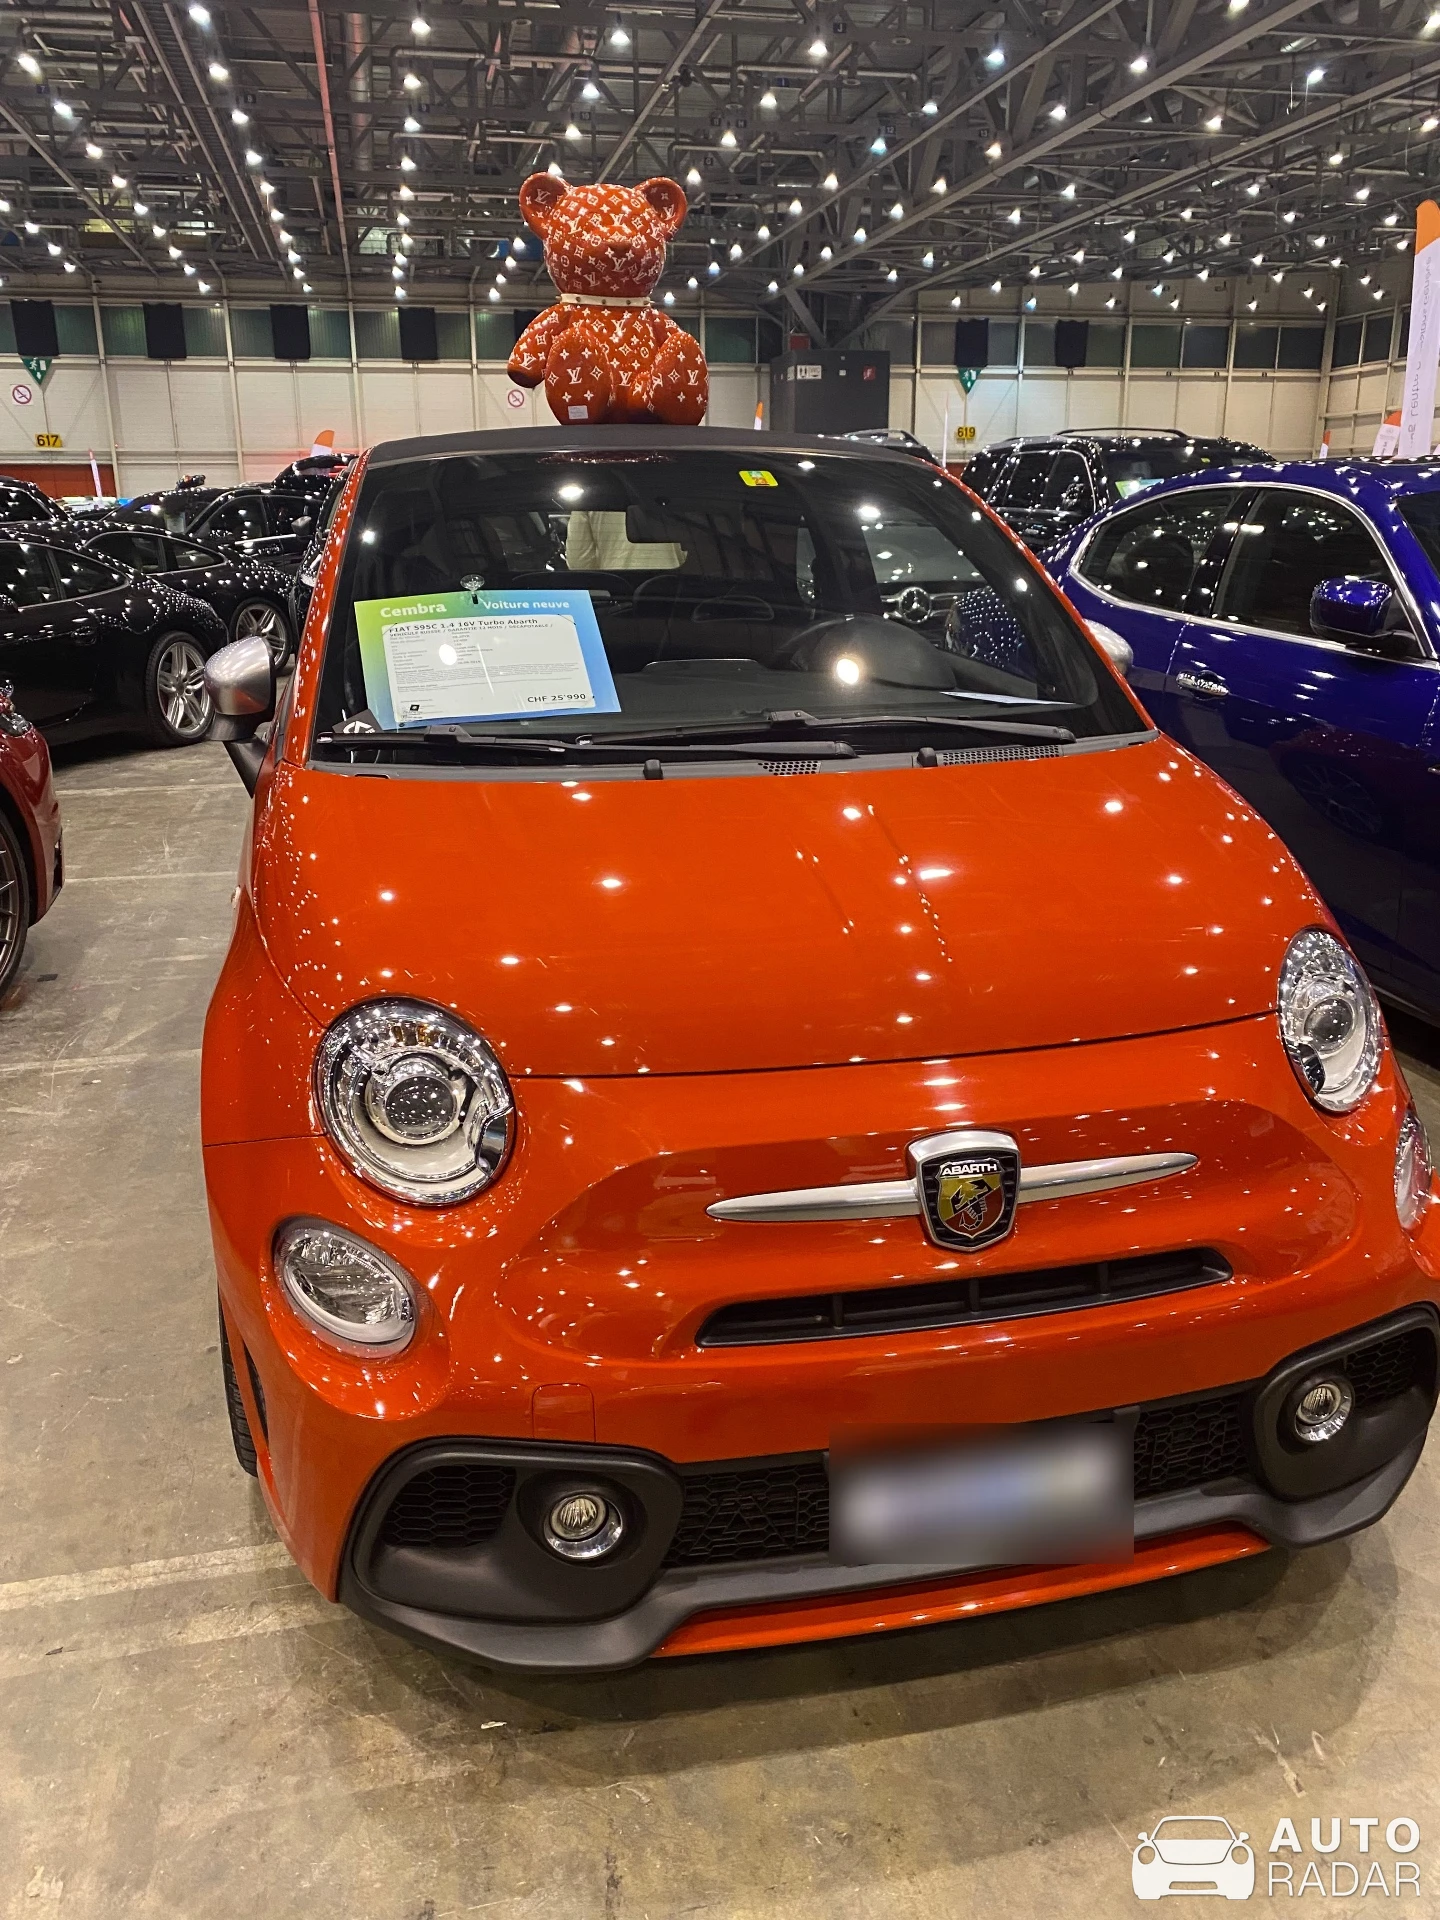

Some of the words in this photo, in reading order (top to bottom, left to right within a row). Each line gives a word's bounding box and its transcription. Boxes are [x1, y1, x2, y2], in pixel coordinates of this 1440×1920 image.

[957, 427, 976, 438] 619
[36, 434, 60, 447] 617
[380, 602, 447, 618] Cembra
[482, 599, 530, 611] Voiture
[532, 600, 570, 609] neuve
[389, 624, 411, 634] FIAT
[414, 622, 438, 631] 595C
[441, 621, 455, 629] 1.4
[459, 620, 475, 628] 16V
[478, 619, 505, 627] Turbo
[507, 618, 538, 626] Abarth
[527, 695, 548, 703] CHF
[551, 693, 587, 702] 25'990
[941, 1163, 998, 1176] ABARTH
